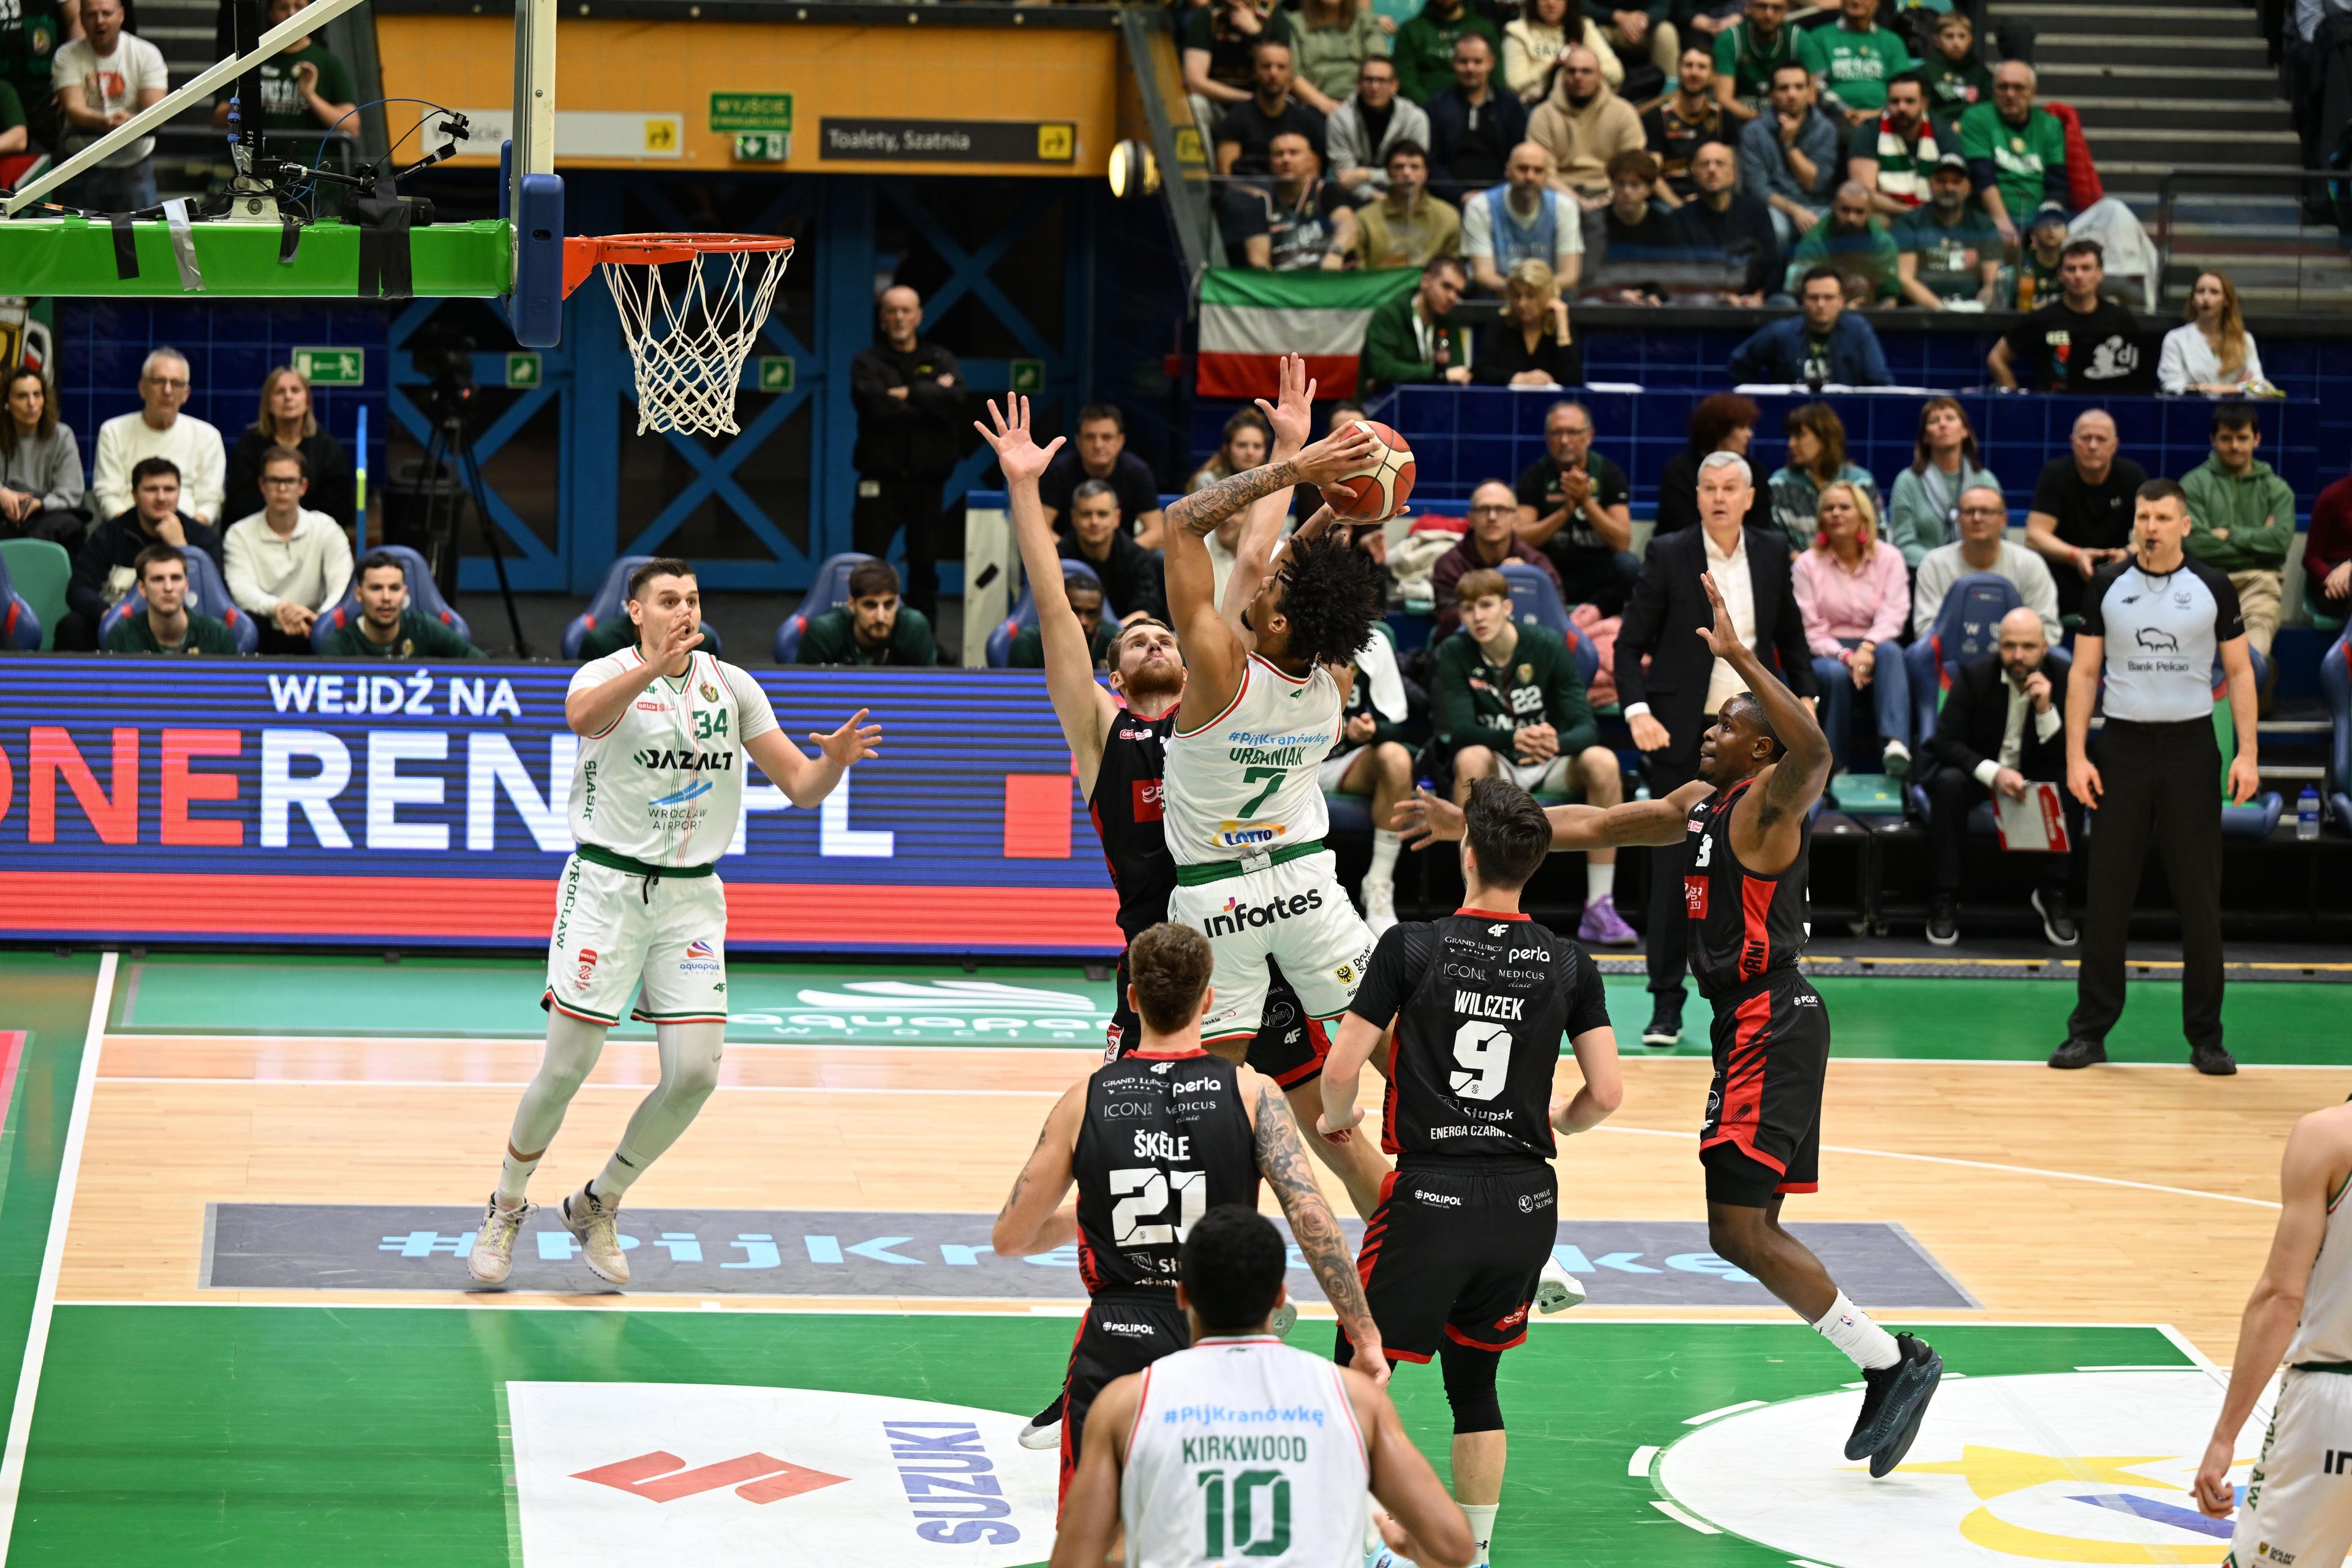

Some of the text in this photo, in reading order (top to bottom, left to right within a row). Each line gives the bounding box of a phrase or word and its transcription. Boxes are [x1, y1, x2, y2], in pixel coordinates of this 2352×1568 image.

[829, 128, 971, 153] Toalety, Szatnia
[2127, 660, 2189, 673] Bank Pekao
[268, 668, 522, 718] WEJDŹ NA
[1510, 685, 1544, 715] 22
[692, 709, 728, 739] 34
[1228, 731, 1330, 747] #PijKranówkę
[647, 749, 734, 771] BAZALT
[1229, 747, 1306, 766] URBANIAK
[1237, 766, 1287, 819] 7
[653, 821, 702, 831] AIRPORT
[1224, 829, 1273, 846] LOTTO
[1204, 889, 1323, 938] infortes
[1444, 936, 1476, 947] GRAND
[1509, 946, 1550, 964] perla
[680, 962, 720, 971] aquapark
[1443, 962, 1481, 980] ICON
[1499, 968, 1545, 980] MEDICUS
[1454, 989, 1525, 1021] WILCZEK
[1449, 1020, 1513, 1101] 9
[1102, 1077, 1136, 1088] GRAND
[1172, 1076, 1221, 1098] perla
[1104, 1102, 1147, 1117] ICON
[1165, 1100, 1217, 1115] MEDICUS
[1430, 1125, 1468, 1140] ENERGA
[1109, 1167, 1207, 1248] 21
[1423, 1192, 1461, 1206] POLIPOL
[1111, 1323, 1155, 1335] POLIPOL
[1164, 1404, 1325, 1427] #PijKranówkę
[1182, 1435, 1308, 1464] KIRKWOOD
[881, 1420, 1021, 1545] SUZUKI
[1197, 1469, 1291, 1559] 10
